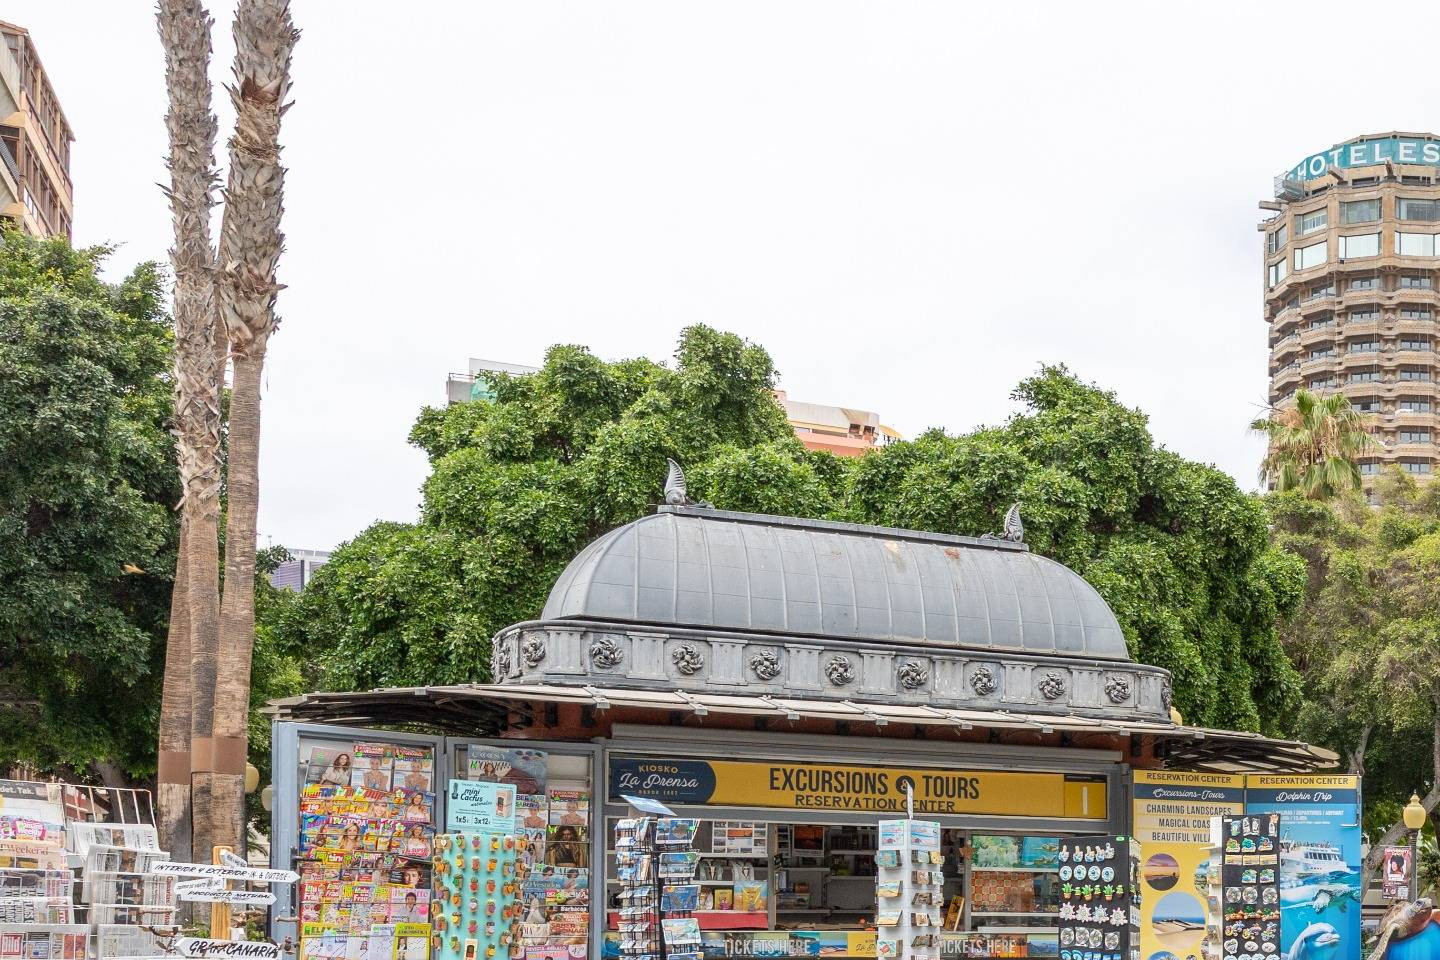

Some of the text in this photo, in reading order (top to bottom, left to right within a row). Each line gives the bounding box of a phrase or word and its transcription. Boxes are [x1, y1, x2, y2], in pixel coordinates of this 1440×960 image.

[1297, 142, 1440, 182] HOTELES
[638, 764, 679, 774] KIOSKO
[618, 773, 699, 789] La Prensa
[769, 767, 889, 796] EXCURSIONS
[922, 775, 980, 800] TOURS
[1146, 772, 1232, 784] RESERVATION CENTER
[1259, 777, 1349, 785] RESERVATION CENTER
[460, 793, 484, 803] Cactus
[795, 794, 897, 811] RESERVATION
[1275, 791, 1333, 802] Dolphin Trip
[1146, 803, 1232, 816] CHARMING LANDSCAPES
[1158, 818, 1211, 829] MAGICAL COAS
[1152, 831, 1211, 843] BEAUTIFUL VILL
[154, 864, 197, 874] INTERIOR
[205, 867, 248, 878] EXTERIOR
[723, 939, 813, 956] TICKETS HERE
[941, 939, 1016, 954] ICKETS HERE
